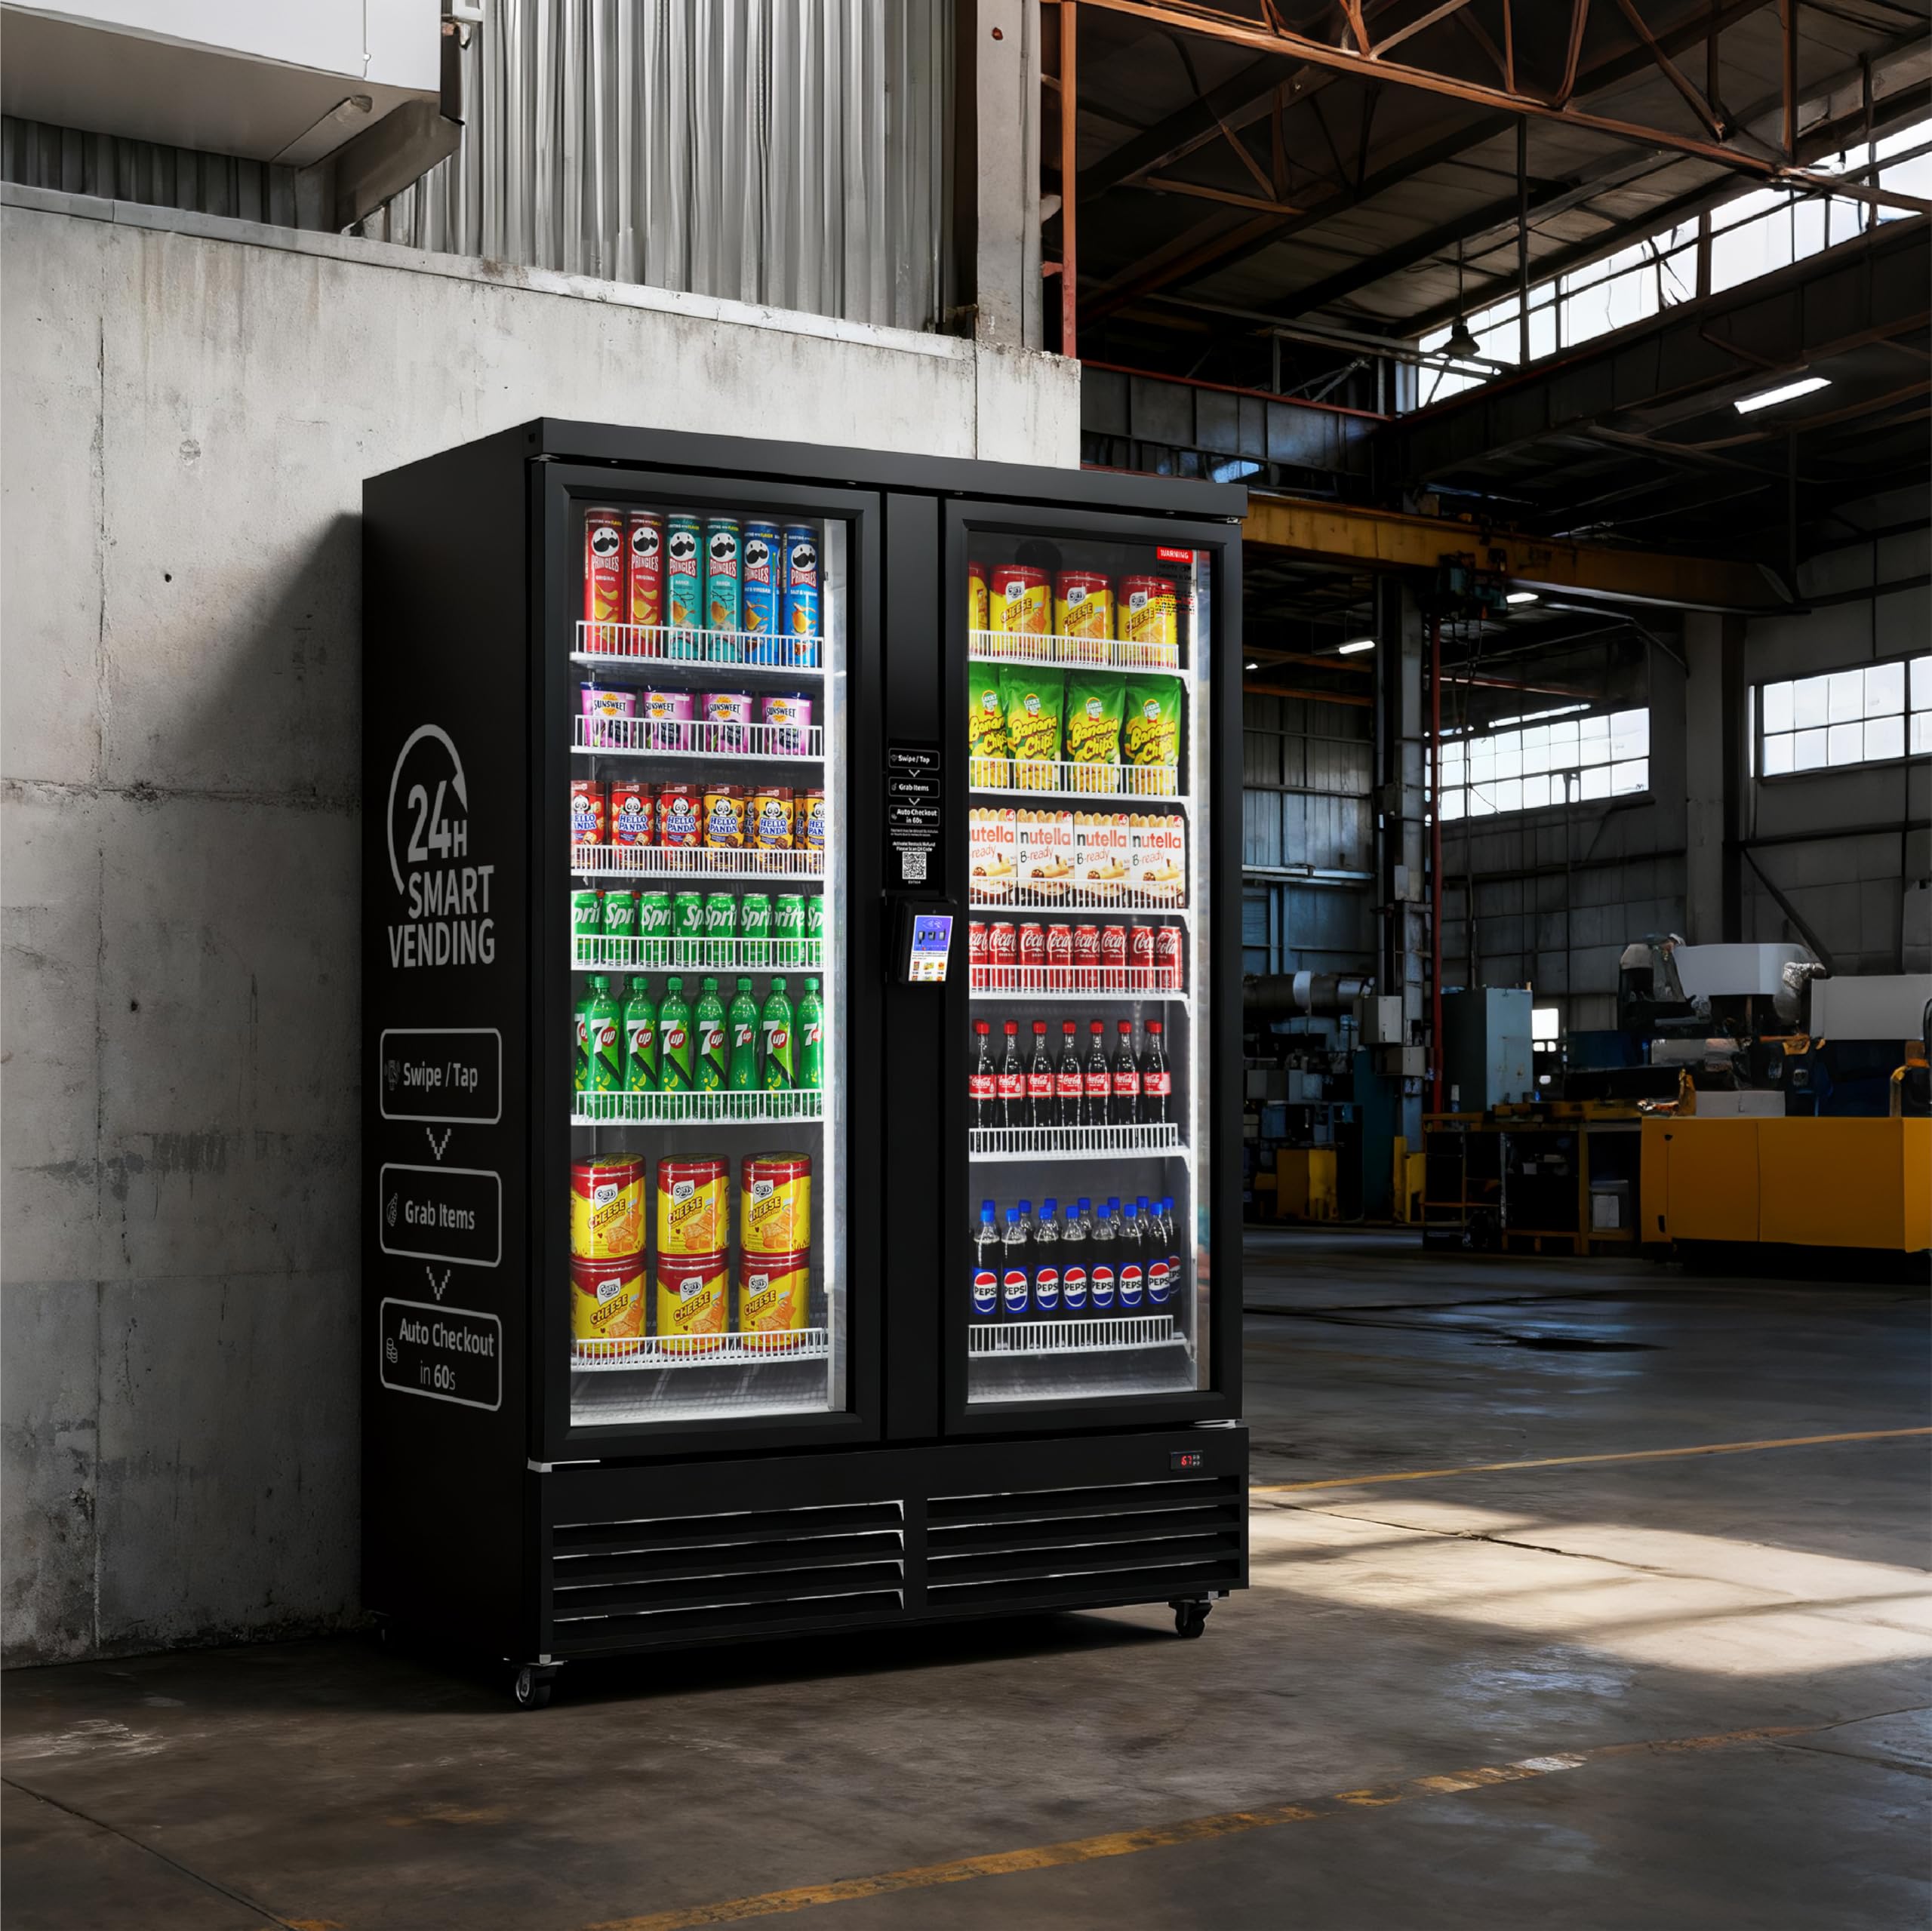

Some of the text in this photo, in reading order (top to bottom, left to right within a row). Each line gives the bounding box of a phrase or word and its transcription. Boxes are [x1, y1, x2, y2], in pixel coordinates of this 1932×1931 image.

[592, 555, 620, 573] PRINGLES
[631, 554, 659, 572] PRINGLES
[1160, 549, 1189, 560] WARNING
[669, 558, 697, 576] PRINGLES
[710, 558, 737, 579] PRINGLES
[791, 568, 817, 588] PRINGLES
[1001, 598, 1032, 623] CHEESE
[1063, 601, 1094, 628] CHEESE
[1124, 607, 1155, 633] CHEESE
[593, 700, 626, 712] SUNSWEET
[645, 702, 675, 713] SUNSWEET
[709, 703, 741, 715] SUNSWEET
[766, 706, 797, 718] SUNSWEET
[1012, 716, 1057, 746] Banana
[1072, 718, 1118, 749] Banana
[1131, 721, 1176, 752] Banana
[1025, 732, 1054, 758] Chips
[1082, 734, 1115, 761] Chips
[1142, 737, 1173, 764] Chips
[898, 755, 915, 764] Swipe
[919, 756, 930, 764] Tap
[408, 779, 467, 862] 24H
[618, 823, 648, 831] PANDA
[666, 823, 697, 832] PANDA
[667, 816, 696, 824] HELLO
[709, 825, 738, 833] PANDA
[710, 816, 737, 825] HELLO
[759, 819, 787, 827] HELLO
[758, 826, 788, 835] PANDA
[808, 827, 824, 835] PAN
[971, 826, 1014, 844] utella
[1020, 827, 1071, 845] nutella
[1077, 829, 1127, 847] nutella
[1132, 832, 1182, 849] nutella
[971, 845, 996, 859] ready
[408, 865, 494, 919] SMART
[705, 905, 737, 931] Spri
[775, 906, 804, 927] rite
[388, 918, 494, 968] VENDING
[404, 1061, 441, 1093] Swipe
[453, 1063, 478, 1093] Tap
[405, 1200, 475, 1230] Grab Items
[588, 1198, 626, 1228] CHEESE
[667, 1196, 703, 1225] CHEESE
[748, 1196, 781, 1222] CHEESE
[1037, 1282, 1059, 1292] PEPS
[1092, 1281, 1113, 1290] PEPS
[1121, 1280, 1142, 1290] PEPS
[1149, 1277, 1170, 1286] PEPS
[590, 1293, 629, 1325] CHEESE
[673, 1291, 710, 1321] CHEESE
[744, 1290, 776, 1317] CHEESE
[399, 1318, 494, 1358] Auto Checkout
[420, 1360, 456, 1390] in 60s
